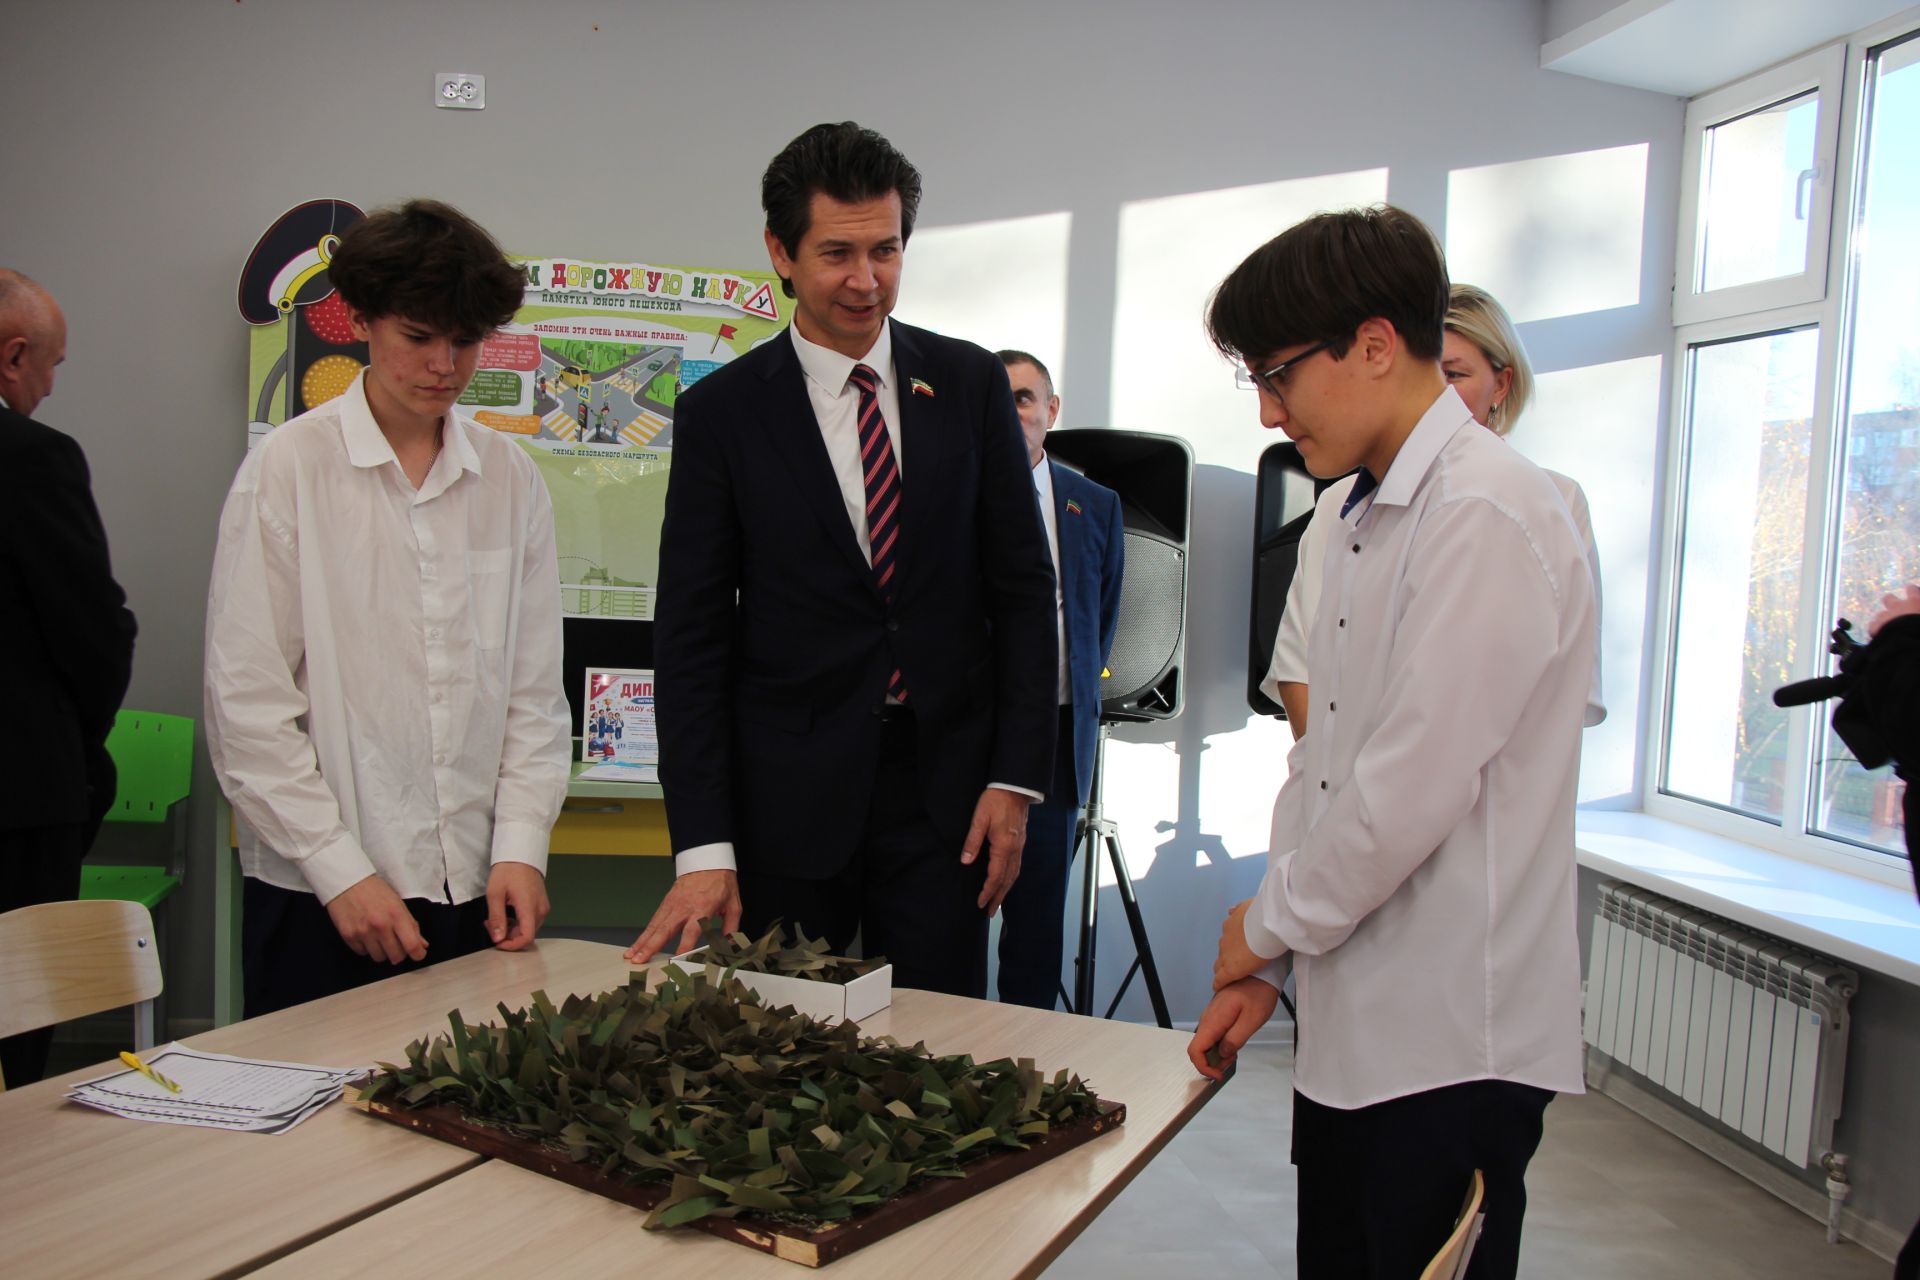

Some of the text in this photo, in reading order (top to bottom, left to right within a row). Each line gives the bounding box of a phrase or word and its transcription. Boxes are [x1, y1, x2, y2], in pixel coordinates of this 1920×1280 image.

[551, 263, 683, 295] ДОРОЖНУЮ
[542, 293, 682, 312] ПАМЯТКА ЮНОГО ПЕШЕХОДА
[533, 324, 689, 342] ЗАПОМНИ ЭТИ ОЧЕНЬ ВАЖНЫЕ ПРАВИЛА:
[623, 452, 659, 461] МАРШРУТА
[620, 683, 656, 698] ДИП
